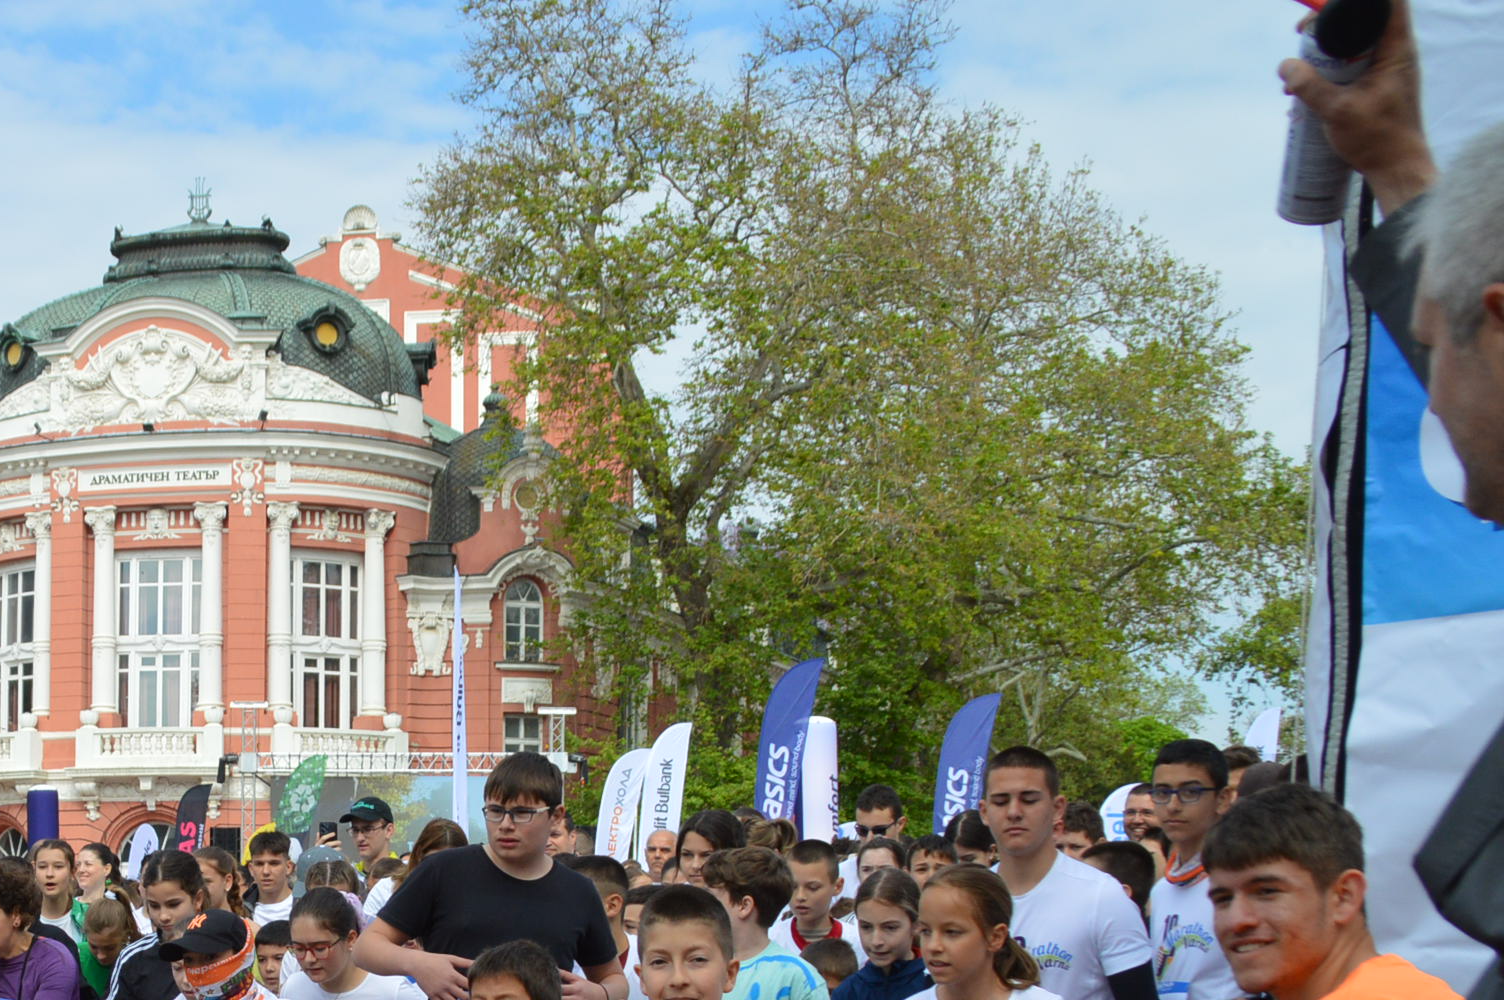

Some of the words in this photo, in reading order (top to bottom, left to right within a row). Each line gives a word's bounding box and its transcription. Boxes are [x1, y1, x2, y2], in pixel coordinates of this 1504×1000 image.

[90, 471, 170, 486] ДРАМАТИЧЕН
[175, 470, 220, 481] ТЕАТЪР
[654, 758, 673, 813] Bulbank
